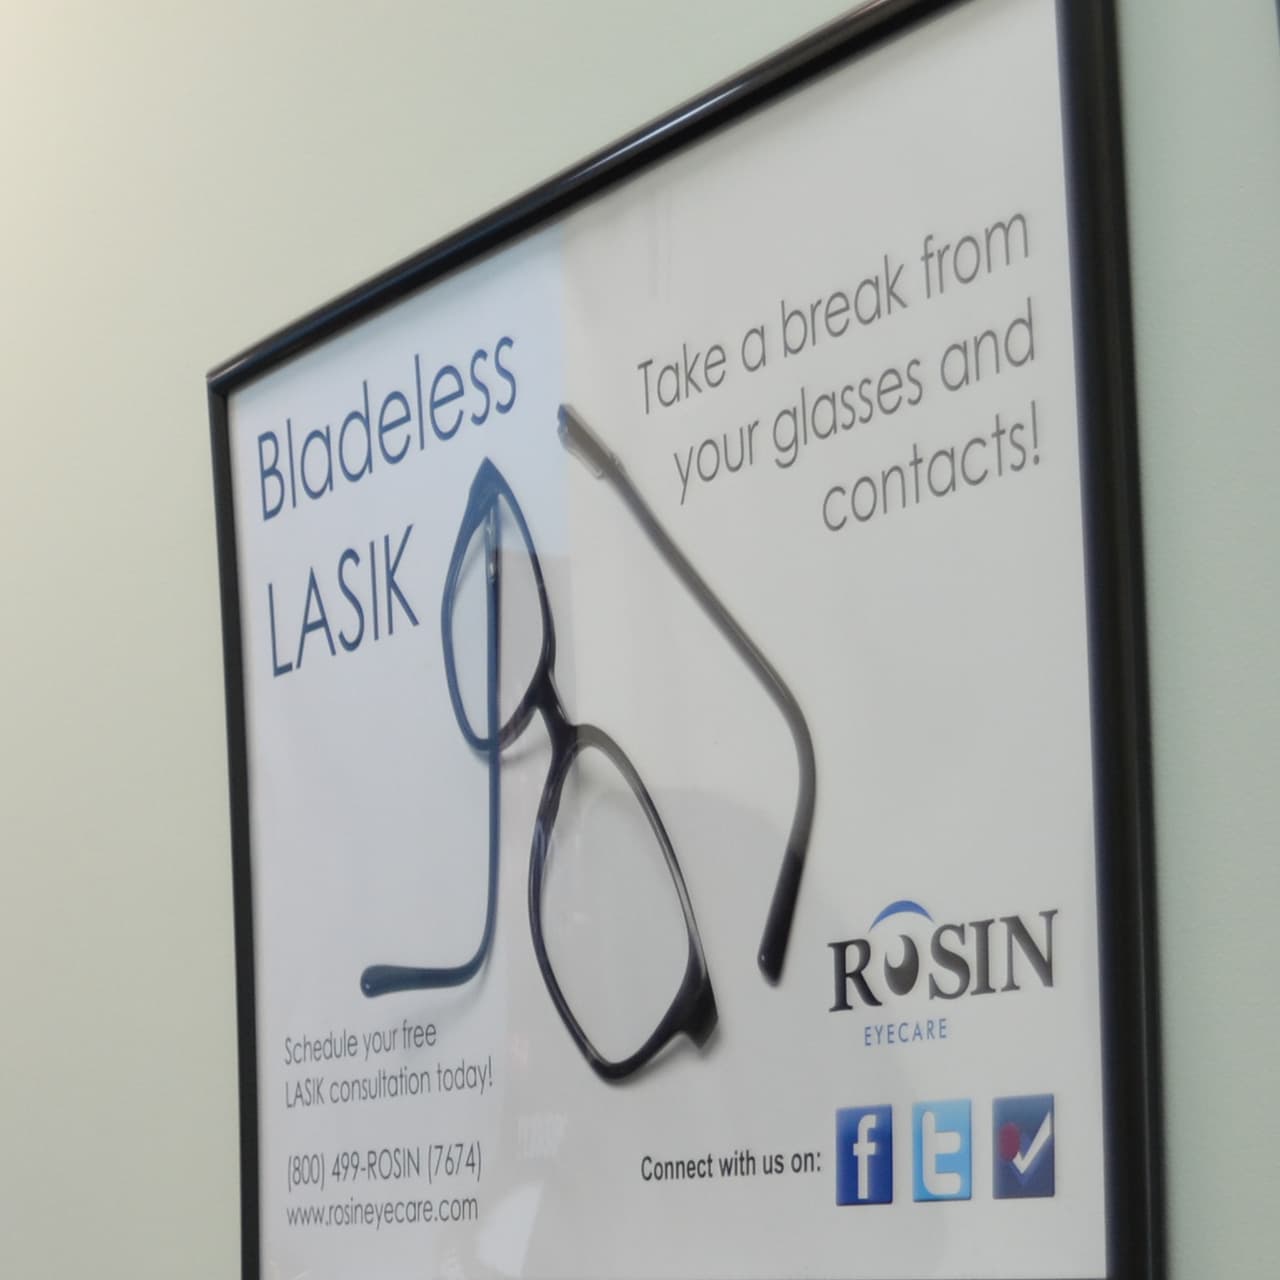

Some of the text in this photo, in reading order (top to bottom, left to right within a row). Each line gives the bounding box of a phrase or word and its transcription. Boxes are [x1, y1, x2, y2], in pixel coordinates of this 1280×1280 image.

[637, 212, 1030, 415] Take a break from
[257, 335, 518, 522] Bladeless
[672, 296, 1036, 506] your glasses and
[822, 399, 1041, 533] contacts!
[267, 523, 421, 678] LASIK
[826, 908, 1059, 1013] ROSIN
[284, 1018, 438, 1066] Schedule your free
[863, 1017, 948, 1047] EYECARE
[284, 1054, 494, 1109] LASIK consultation today!
[287, 1140, 483, 1193] (800) 499-ROSIN (7674)
[640, 1149, 822, 1182] Connect with us on:
[286, 1196, 480, 1232] www.rosineyecare.com
